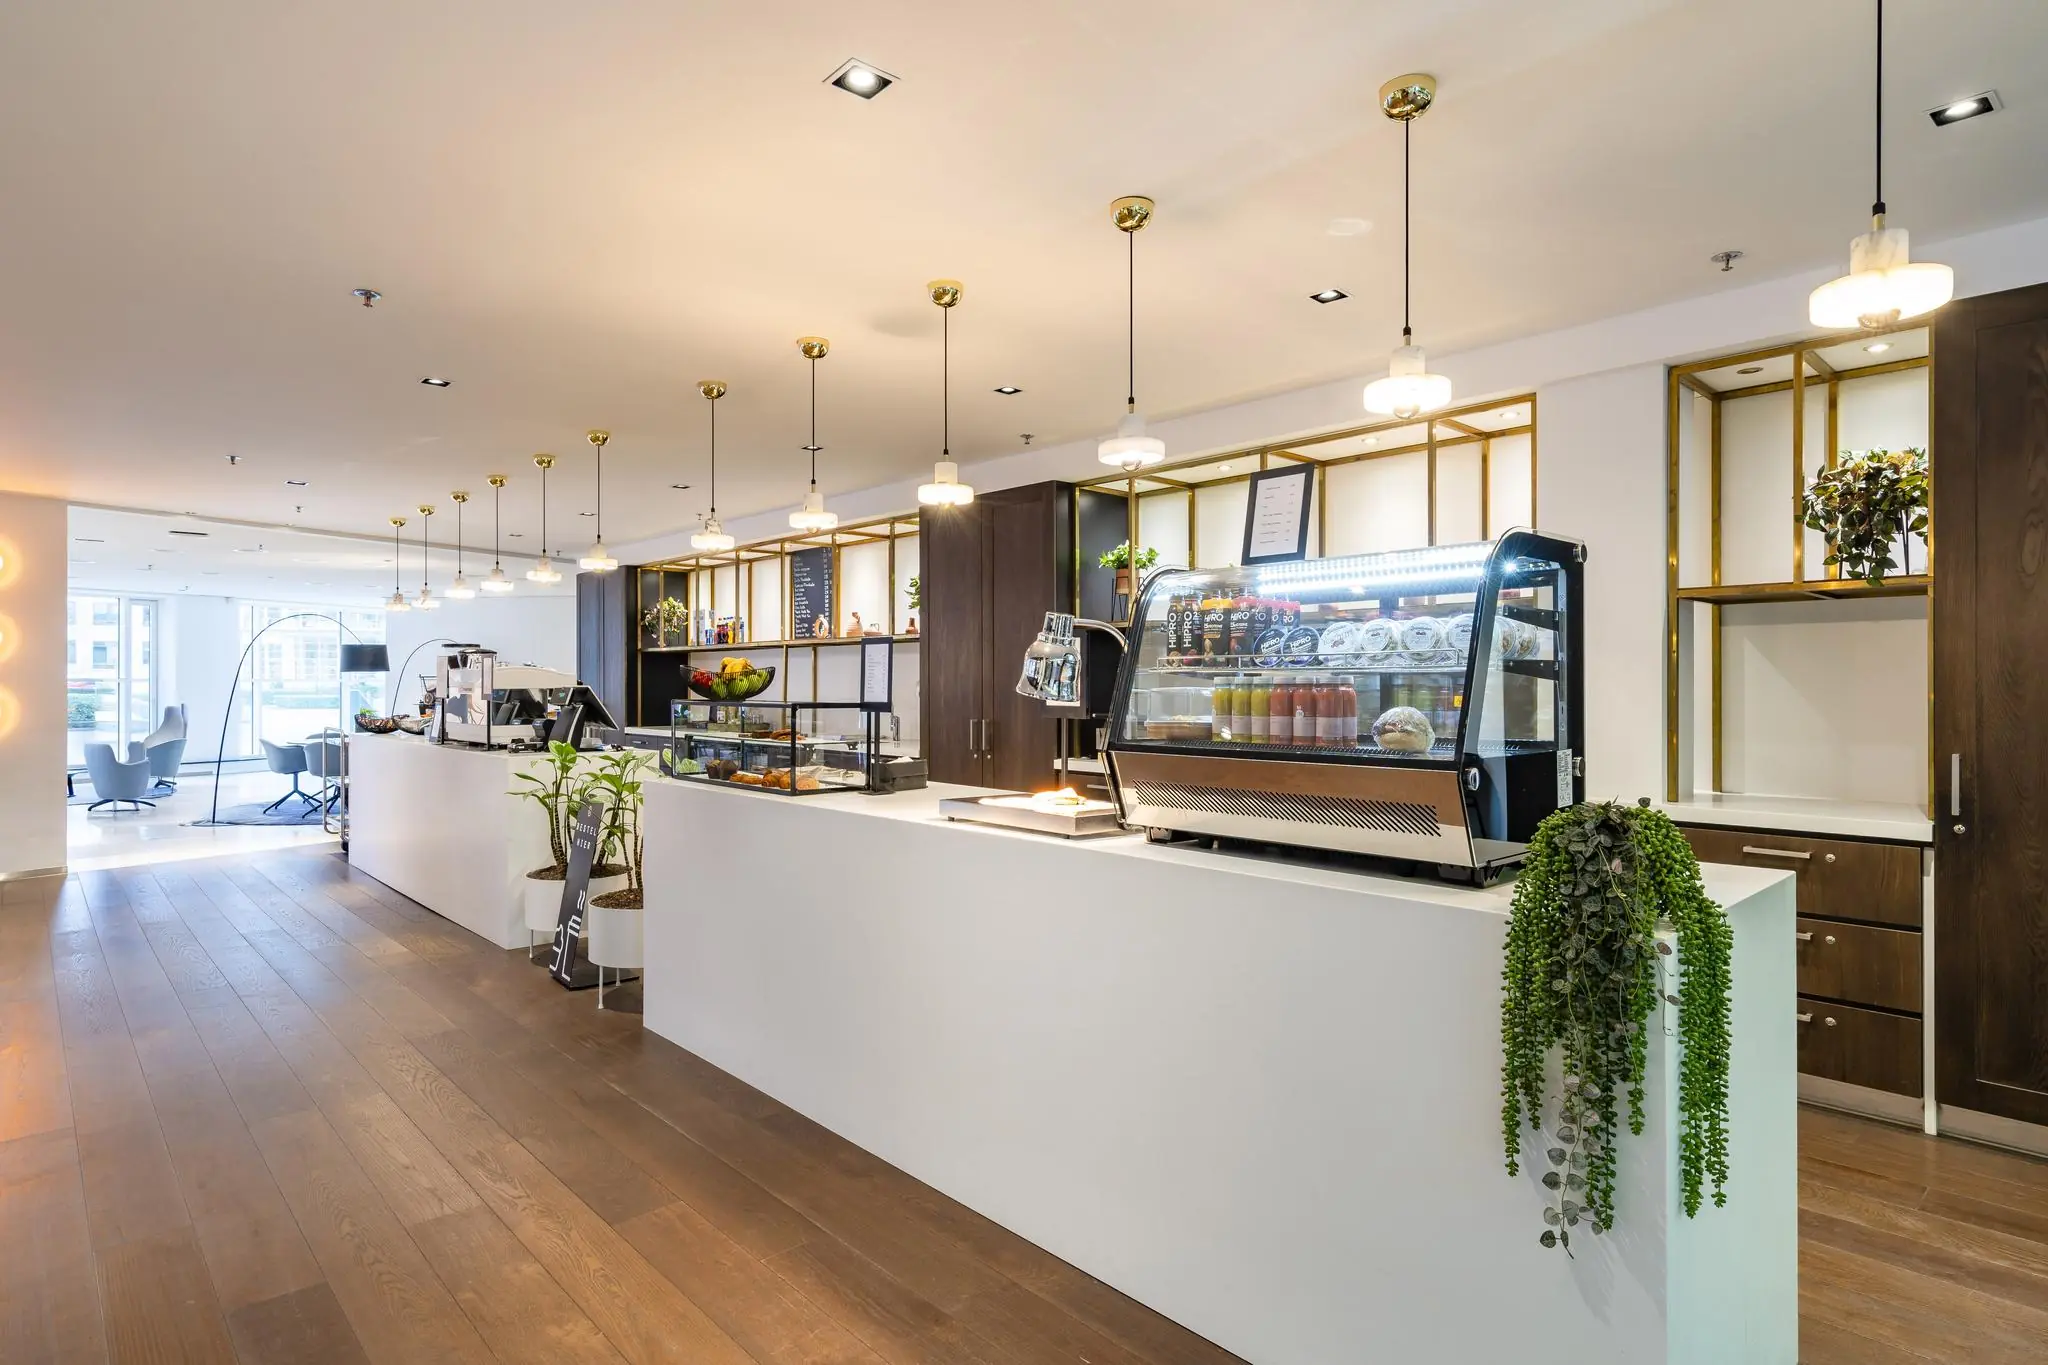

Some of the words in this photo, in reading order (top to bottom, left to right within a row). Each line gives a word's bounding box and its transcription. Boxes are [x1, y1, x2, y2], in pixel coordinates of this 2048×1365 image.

[1168, 612, 1177, 648] HiPRO
[1183, 611, 1193, 648] HiPRO
[576, 822, 597, 836] BESTEL
[576, 838, 591, 850] HIER
